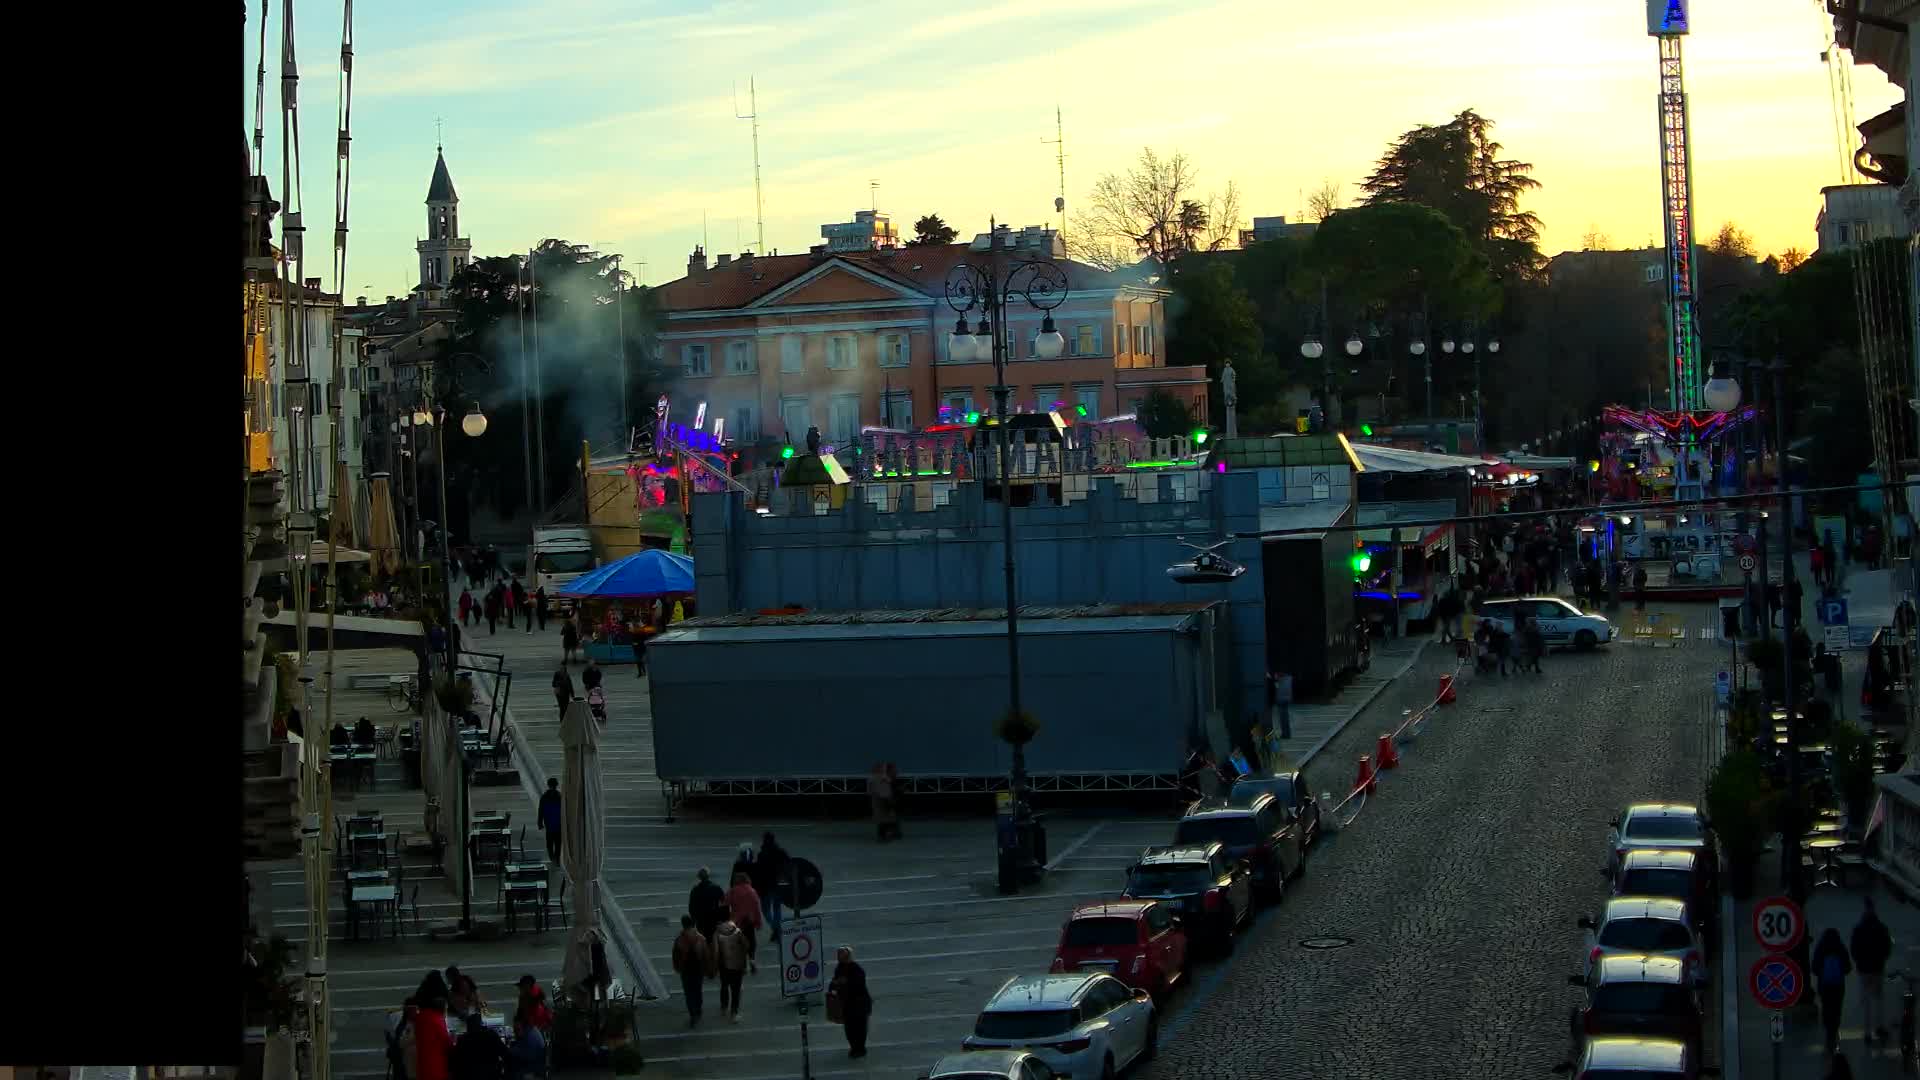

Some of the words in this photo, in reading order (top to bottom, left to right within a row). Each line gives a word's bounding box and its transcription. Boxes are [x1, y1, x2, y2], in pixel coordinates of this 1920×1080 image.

[1742, 557, 1752, 566] 20
[1827, 603, 1841, 622] P
[1762, 912, 1791, 938] 30
